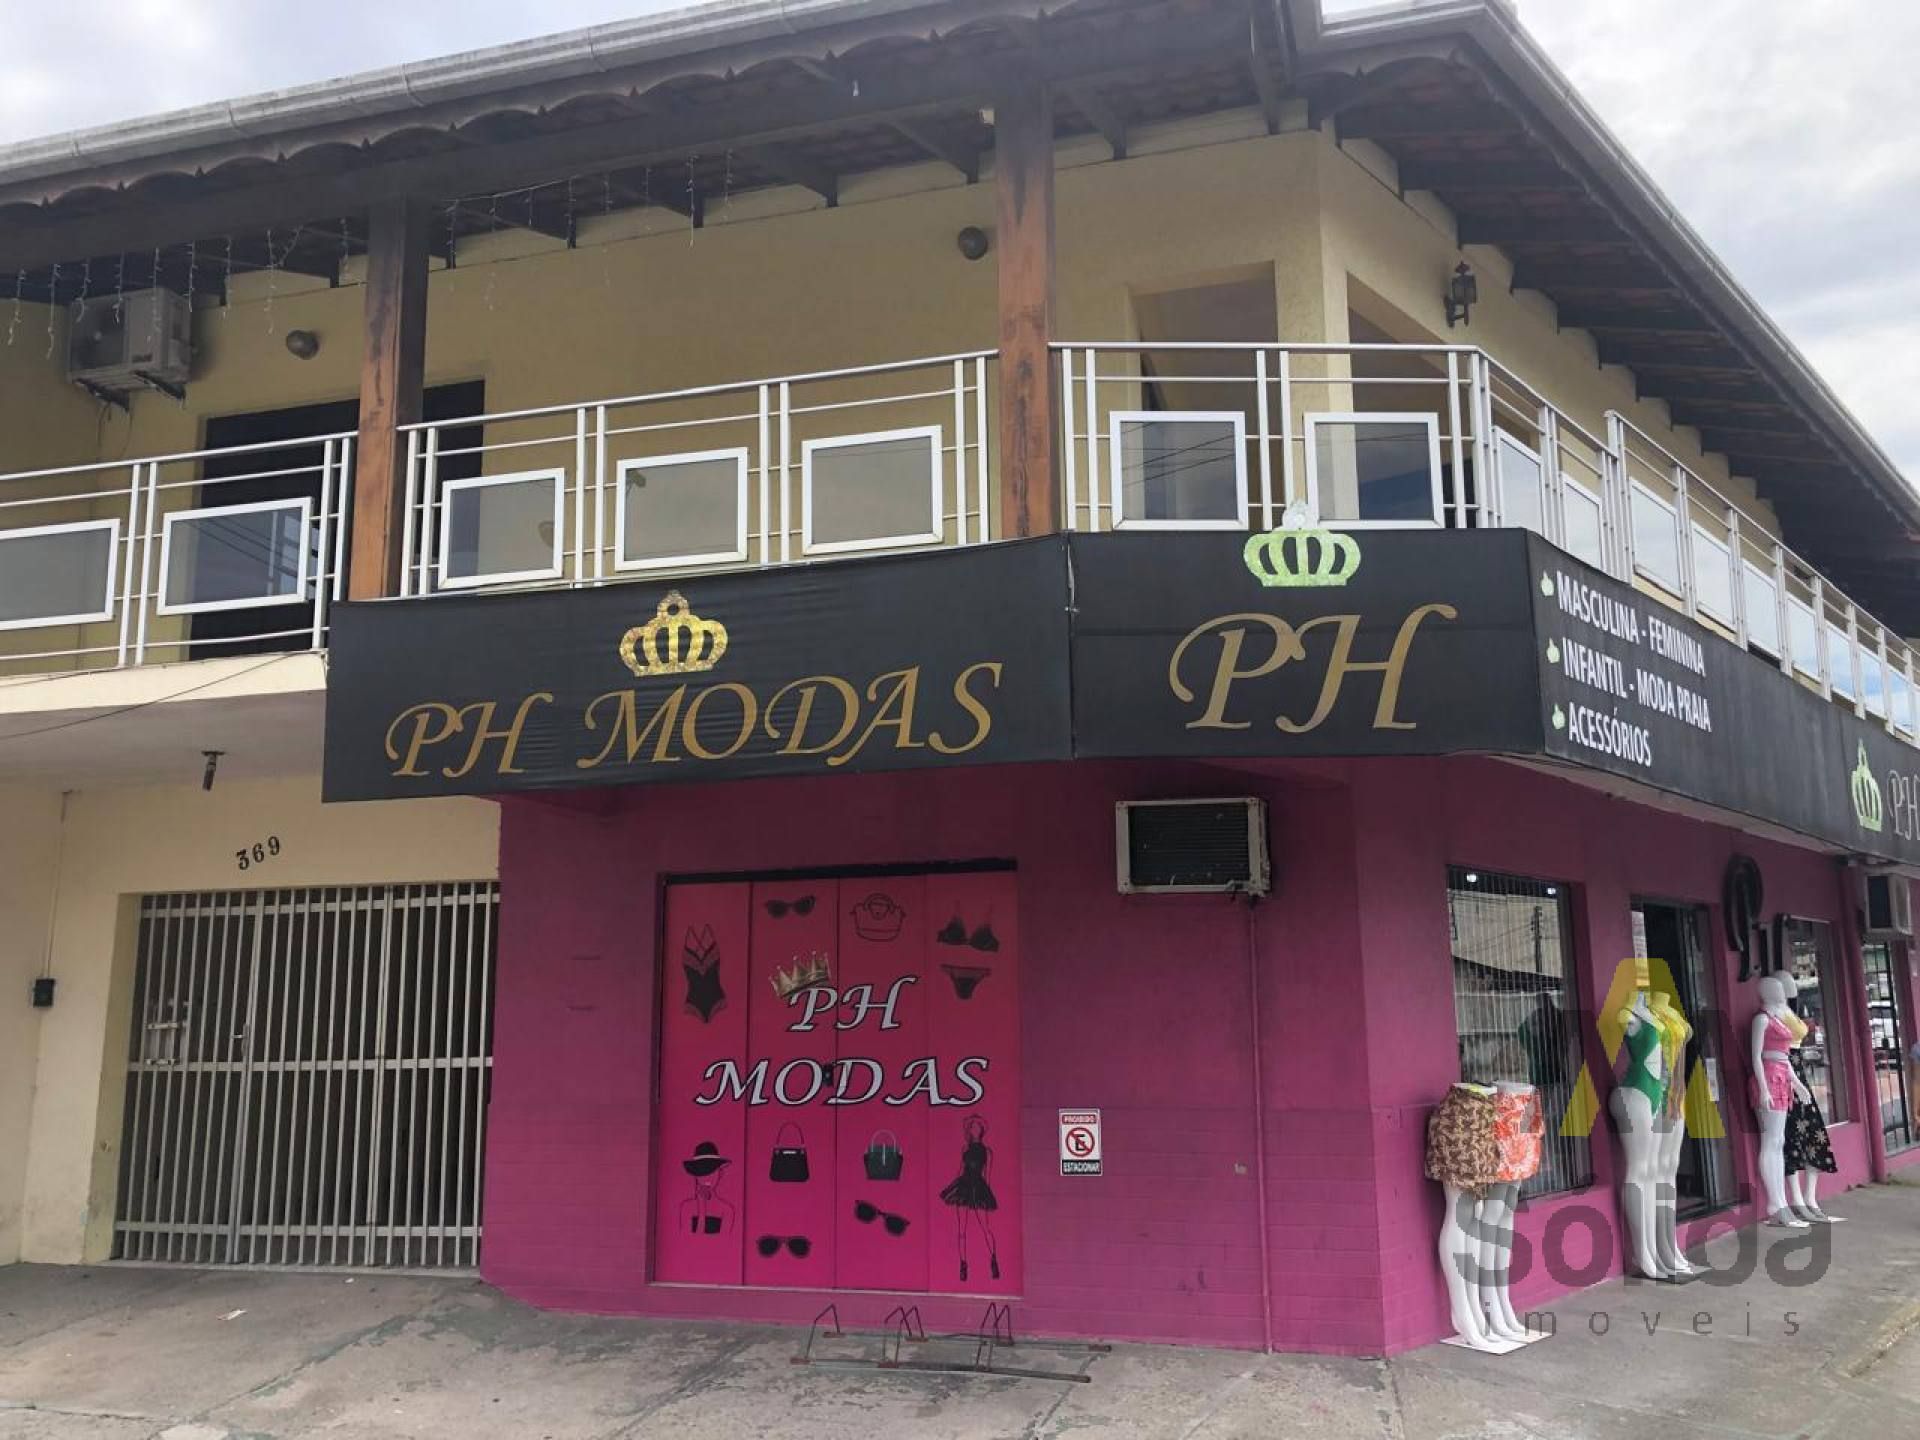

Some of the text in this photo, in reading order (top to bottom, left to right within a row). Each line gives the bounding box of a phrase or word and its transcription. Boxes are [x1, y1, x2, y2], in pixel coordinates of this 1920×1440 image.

[1556, 570, 1640, 645] MASCULINA
[1648, 615, 1707, 677] FEMININA
[1168, 603, 1459, 733] PH
[1562, 637, 1628, 699] INFANTIL
[1637, 668, 1677, 718] MODA
[1677, 686, 1713, 733] PRAIA
[385, 661, 1003, 778] PH MODAS
[1569, 702, 1652, 768] ACESSÓRIOS
[236, 836, 281, 871] 369
[786, 975, 917, 1033] PH
[692, 1056, 991, 1108] MODAS
